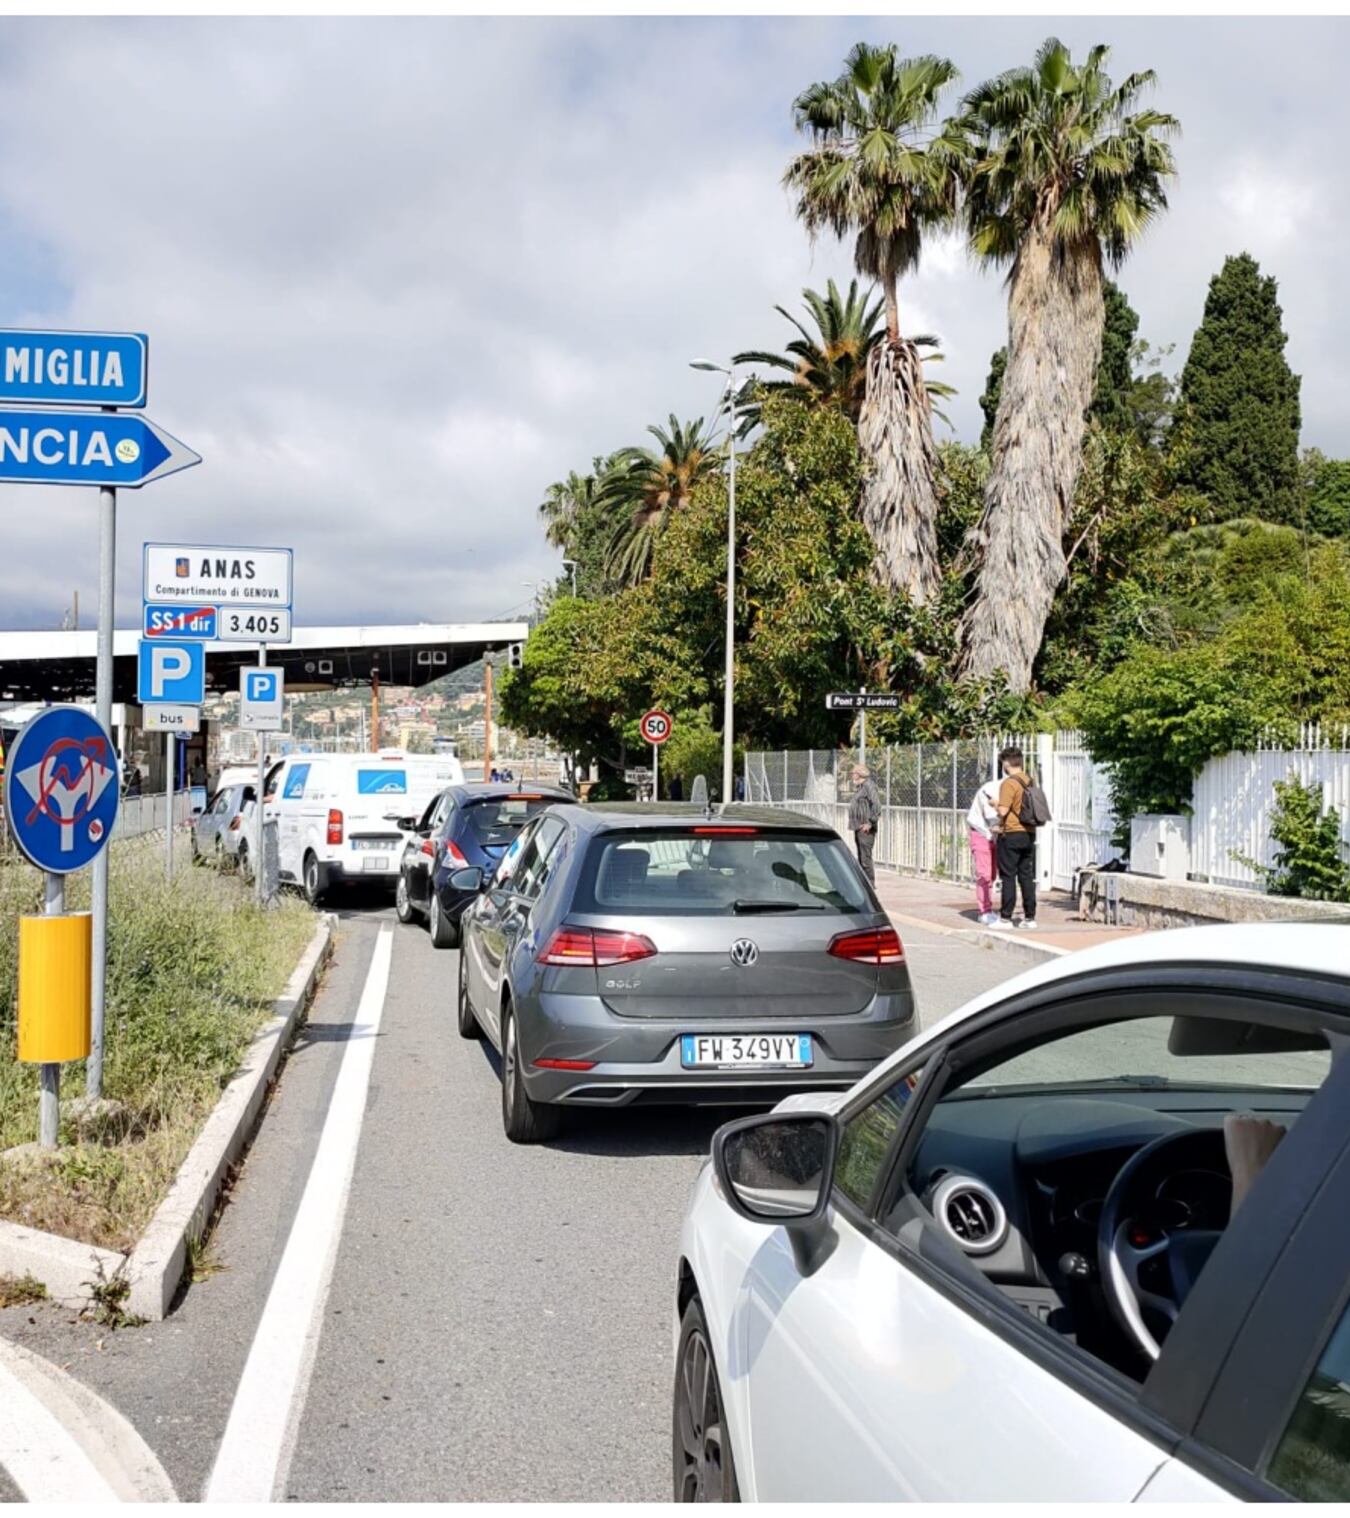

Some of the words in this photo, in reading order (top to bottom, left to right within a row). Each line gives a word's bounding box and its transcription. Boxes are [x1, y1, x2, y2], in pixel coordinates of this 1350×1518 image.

[5, 346, 125, 387] MIGLIA
[0, 427, 114, 466] NCIA
[200, 558, 256, 580] ANAS
[155, 584, 227, 598] Compartimento
[230, 586, 240, 597] di
[243, 587, 280, 599] GENOVA
[190, 616, 211, 632] dir
[229, 615, 280, 635] 3.405
[151, 647, 192, 697] P
[253, 676, 271, 699] P
[833, 695, 854, 706] Pont
[867, 697, 899, 708] Ludovic
[160, 712, 183, 724] bus
[647, 719, 666, 734] 50
[605, 978, 642, 990] GOLF
[698, 1037, 726, 1062] FW
